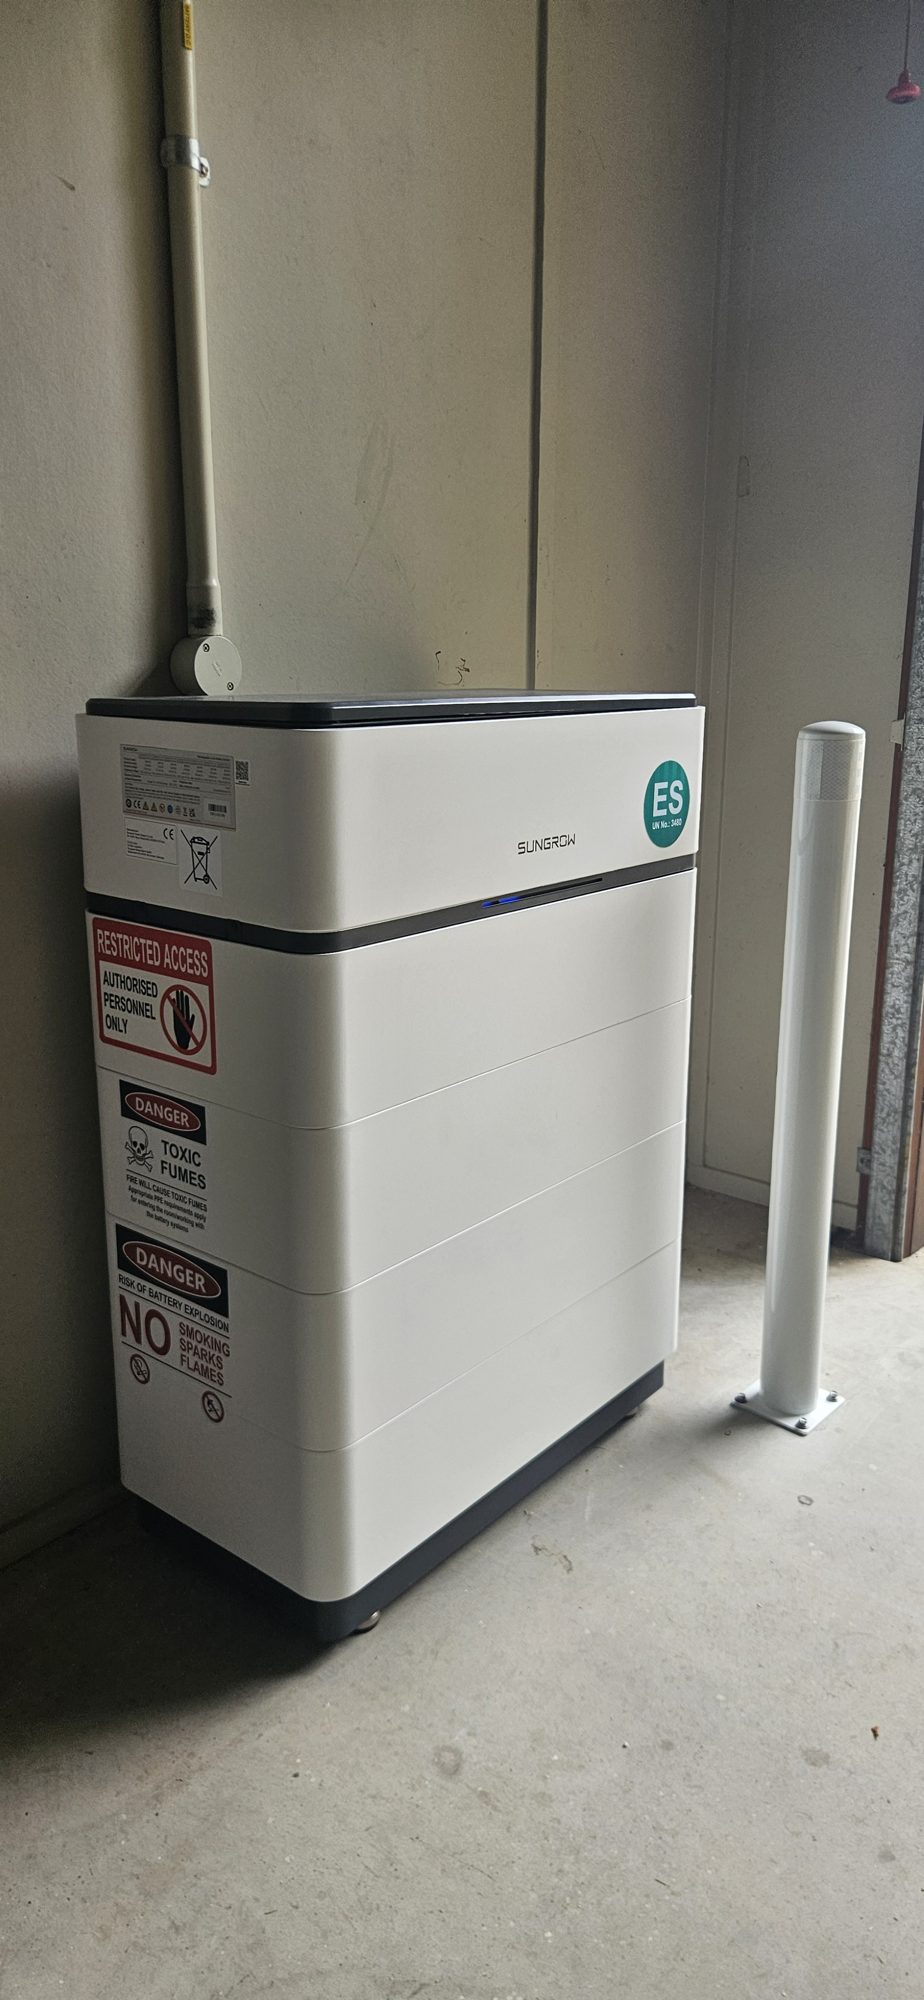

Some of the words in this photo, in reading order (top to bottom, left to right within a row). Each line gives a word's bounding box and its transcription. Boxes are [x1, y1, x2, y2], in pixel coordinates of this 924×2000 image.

[653, 780, 683, 817] ES
[652, 821, 660, 830] UN
[671, 818, 682, 827] 3480
[518, 833, 576, 855] SUNGROW
[97, 929, 161, 966] RESTRICTED
[164, 943, 209, 978] ACCESS
[103, 970, 158, 998] AUTHORISED
[104, 992, 156, 1020] PERSONNEL
[105, 1014, 128, 1034] ONLY
[135, 1097, 190, 1128] DANGER
[161, 1139, 202, 1167] TOXIC
[161, 1160, 207, 1190] FUMES
[126, 1174, 138, 1185] FIRE
[139, 1179, 152, 1190] WILL
[152, 1184, 171, 1198] CAUSE
[171, 1191, 188, 1204] TOXIC
[188, 1197, 208, 1212] FUMES
[128, 1185, 154, 1200] Appropriate
[154, 1195, 163, 1204] PPE
[164, 1200, 194, 1216] requirements
[194, 1212, 207, 1223] apply
[138, 1199, 156, 1212] entering
[156, 1205, 164, 1213] the
[195, 1221, 205, 1230] with
[154, 1214, 170, 1227] battery
[170, 1221, 189, 1233] systems
[136, 1247, 206, 1294] DANGER
[118, 1274, 135, 1290] RISK
[136, 1282, 147, 1294] OF
[148, 1287, 183, 1310] BATTERY
[184, 1304, 230, 1333] EXPLOSION
[119, 1293, 171, 1356] NO
[179, 1321, 230, 1358] SMOKING
[179, 1338, 224, 1370] SPARKS
[180, 1355, 225, 1386] FLAMES
